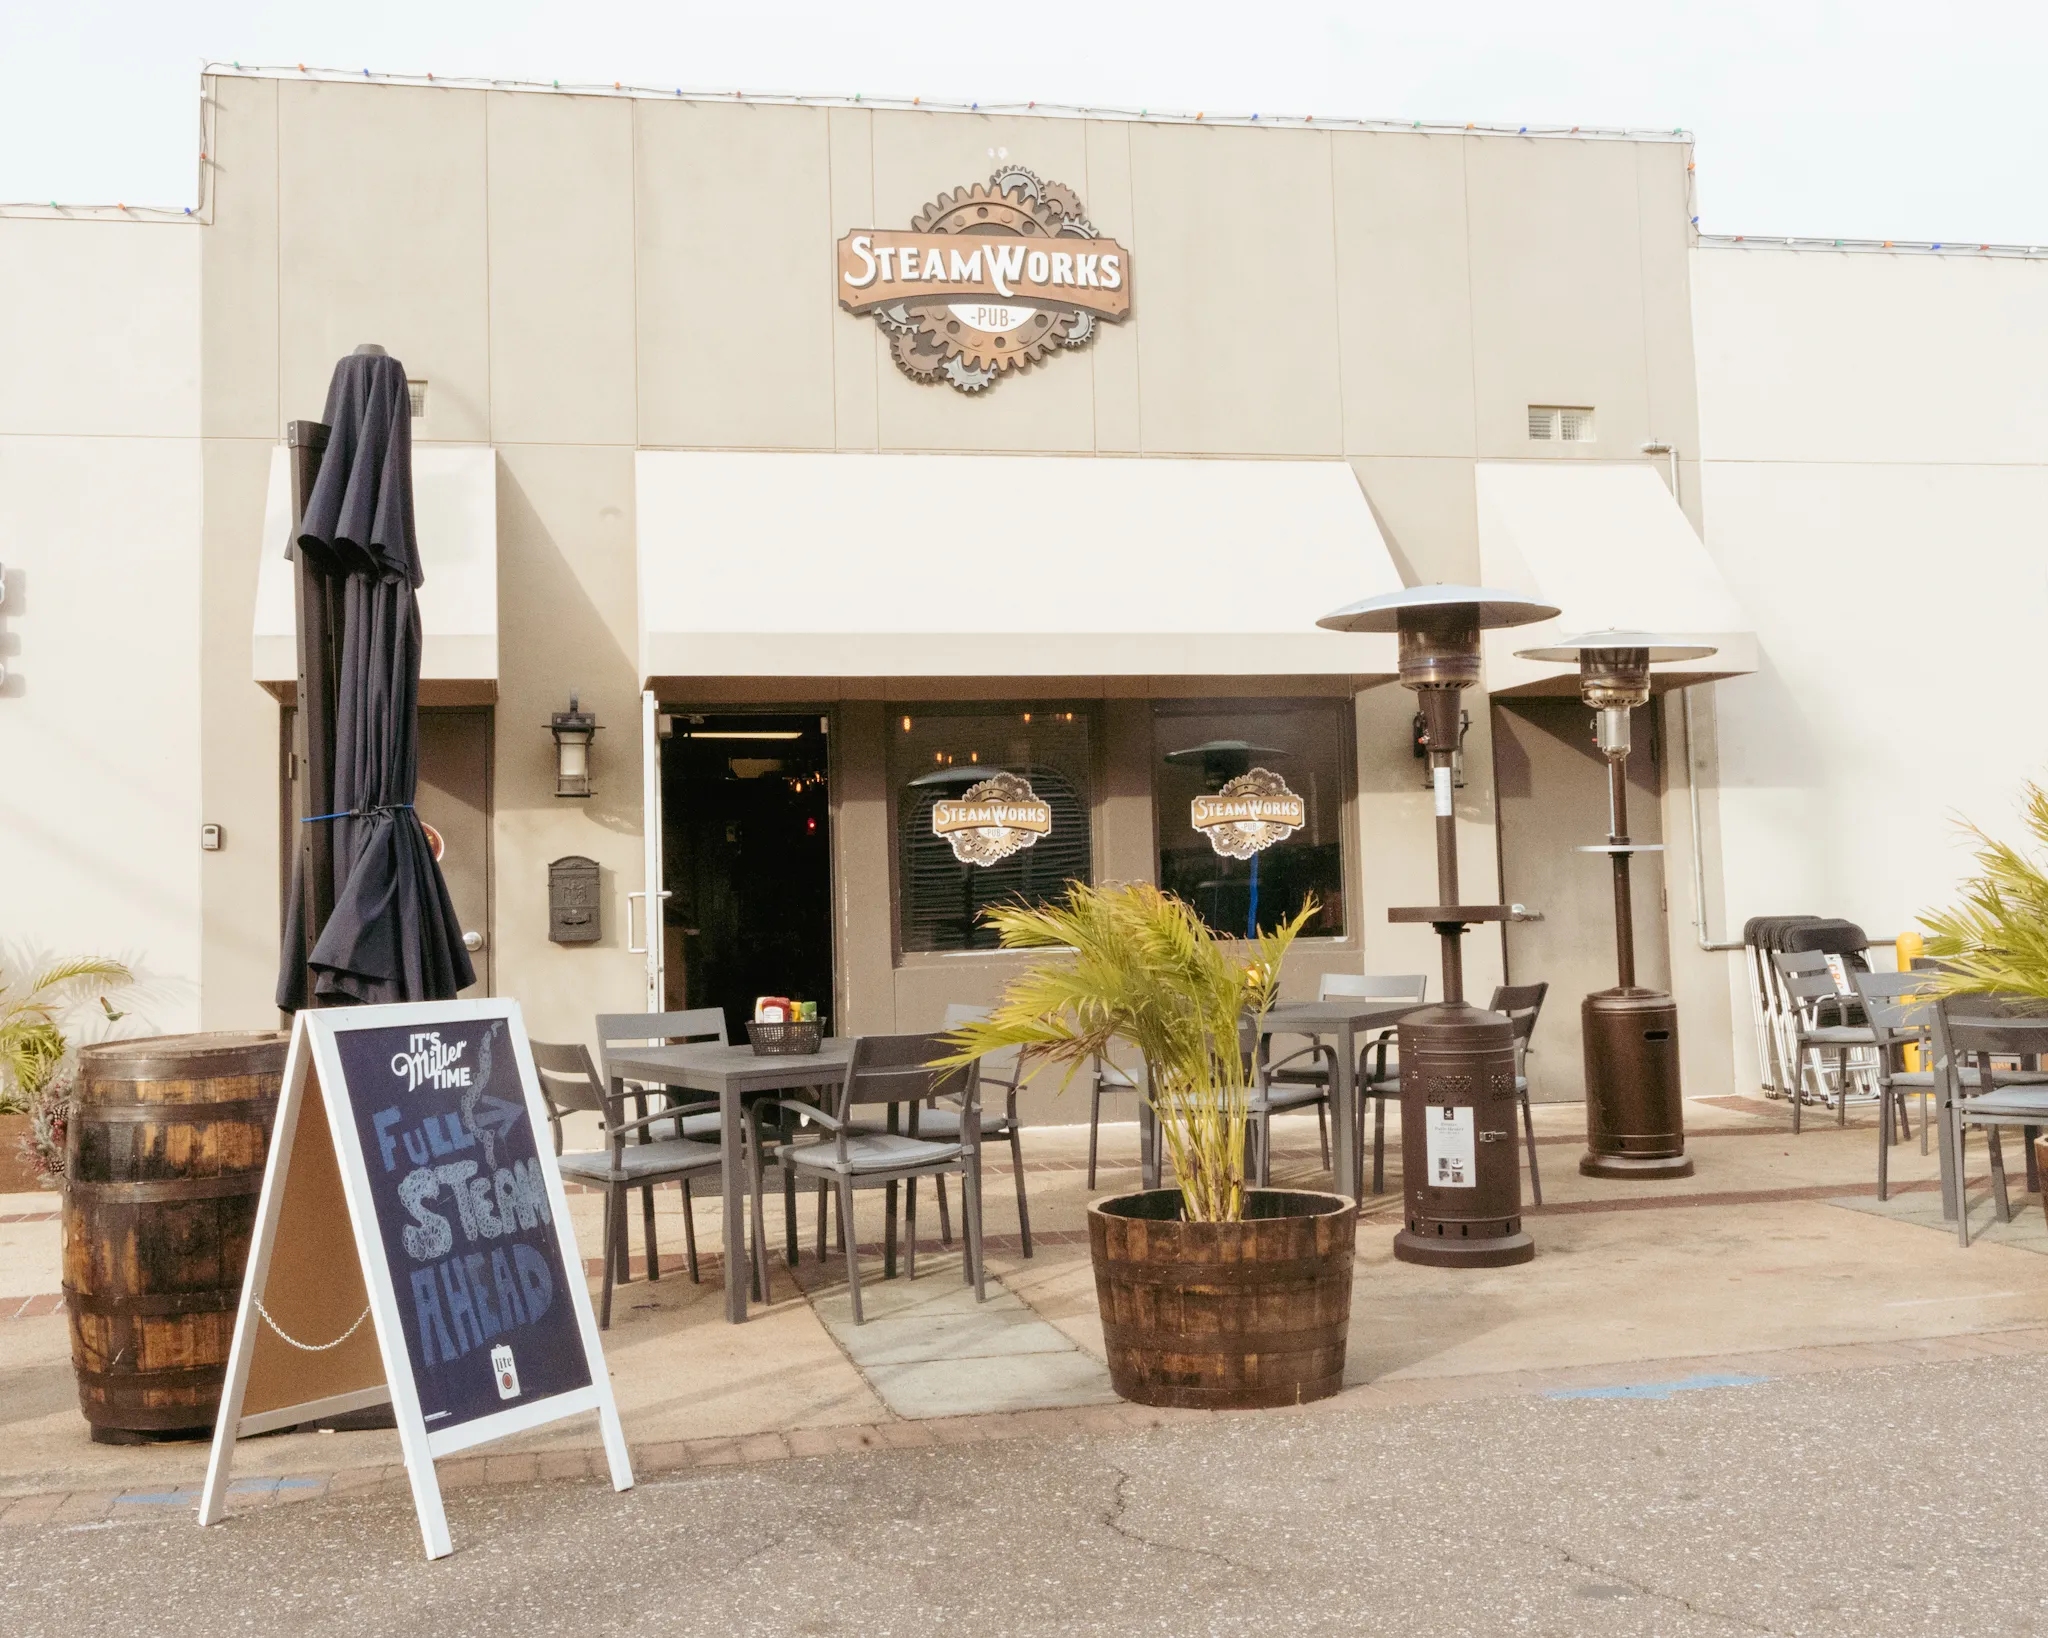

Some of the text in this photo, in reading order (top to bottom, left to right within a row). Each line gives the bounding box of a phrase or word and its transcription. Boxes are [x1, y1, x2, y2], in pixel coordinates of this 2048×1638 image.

[409, 1032, 441, 1053] IT'S
[391, 1040, 467, 1092] Miller
[410, 1243, 553, 1368] AHEAD
[495, 1357, 512, 1373] Lite
